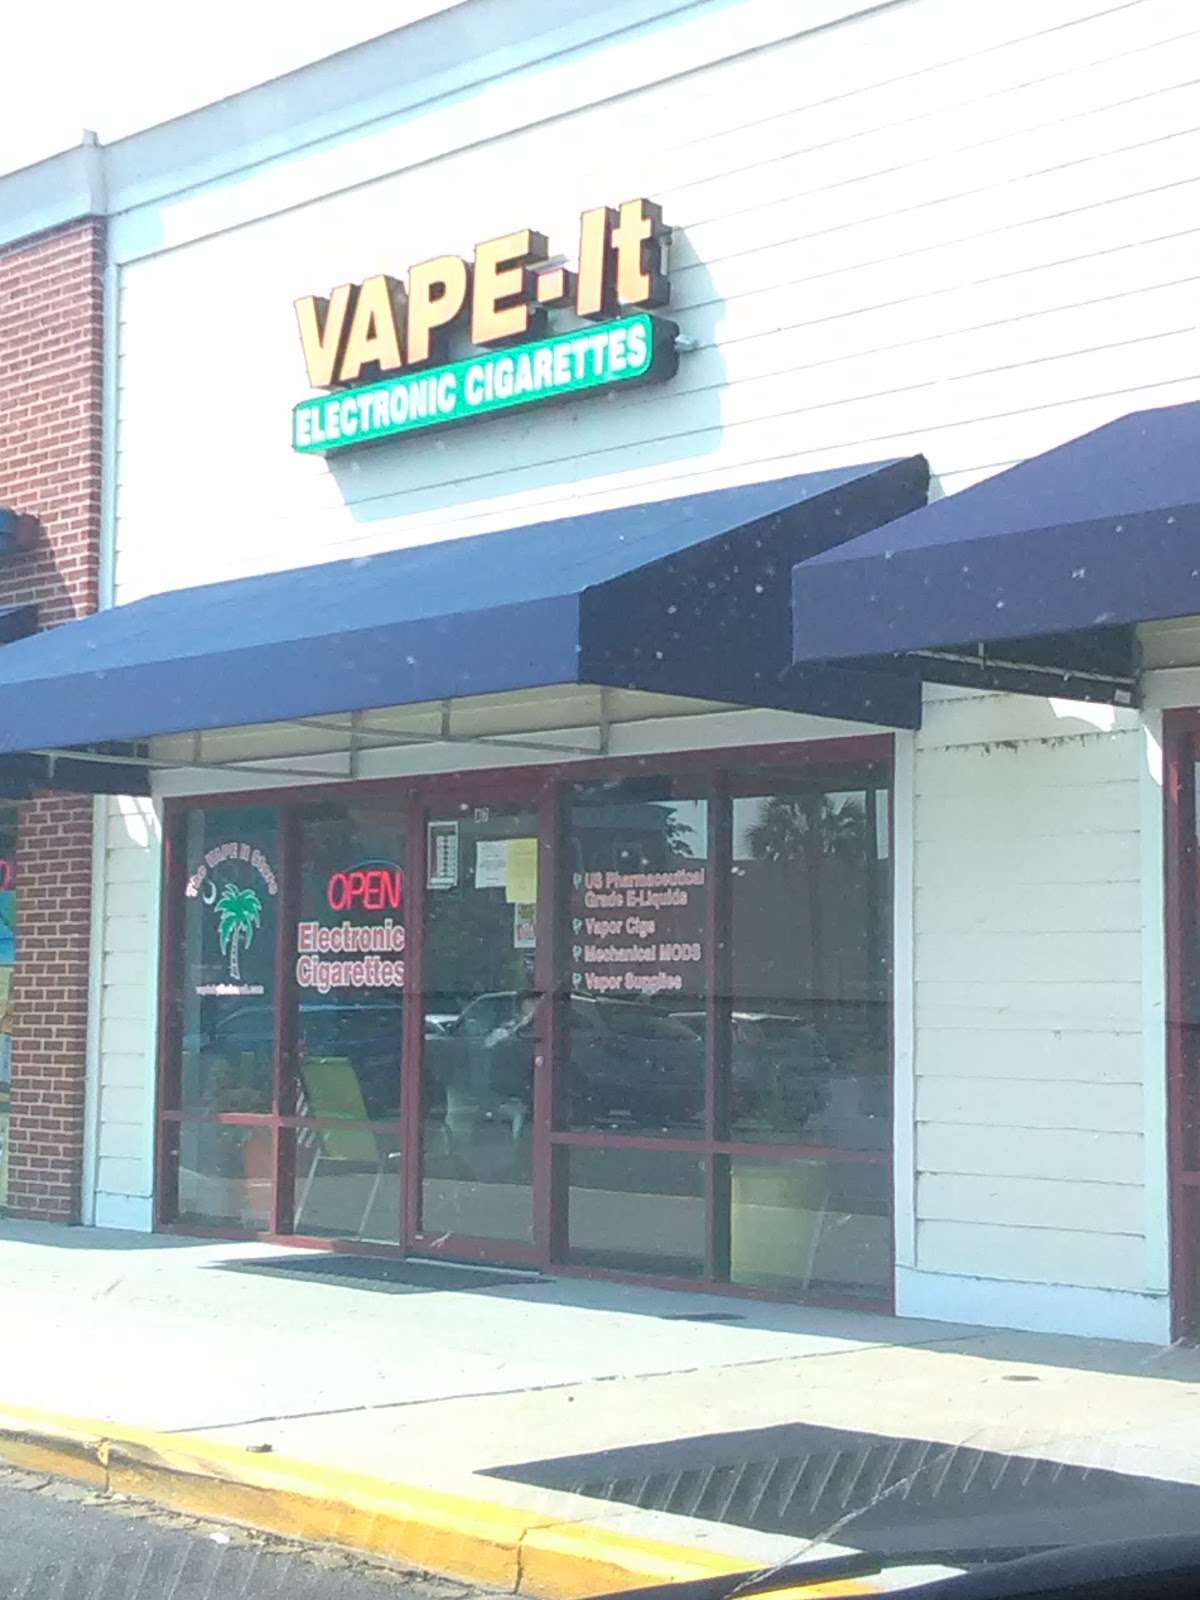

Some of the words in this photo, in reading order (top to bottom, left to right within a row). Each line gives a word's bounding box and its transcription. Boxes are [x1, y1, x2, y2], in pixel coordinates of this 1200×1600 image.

[294, 198, 652, 388] VAPE-It
[296, 372, 457, 446] ELECTRONIC
[465, 323, 648, 406] CIGARETTES
[328, 871, 402, 911] OPEN
[605, 868, 705, 889] Pharmaceutical
[584, 891, 623, 908] Grade
[626, 888, 688, 910] E-Liquids
[297, 919, 405, 952] Electronic
[584, 918, 623, 939] Vapor
[625, 916, 656, 938] Cigs
[584, 944, 656, 962] Mechanical
[659, 943, 701, 961] MODS
[296, 955, 405, 994] Cigarettes
[584, 972, 623, 993] Vapor
[624, 971, 682, 995] Supplies
